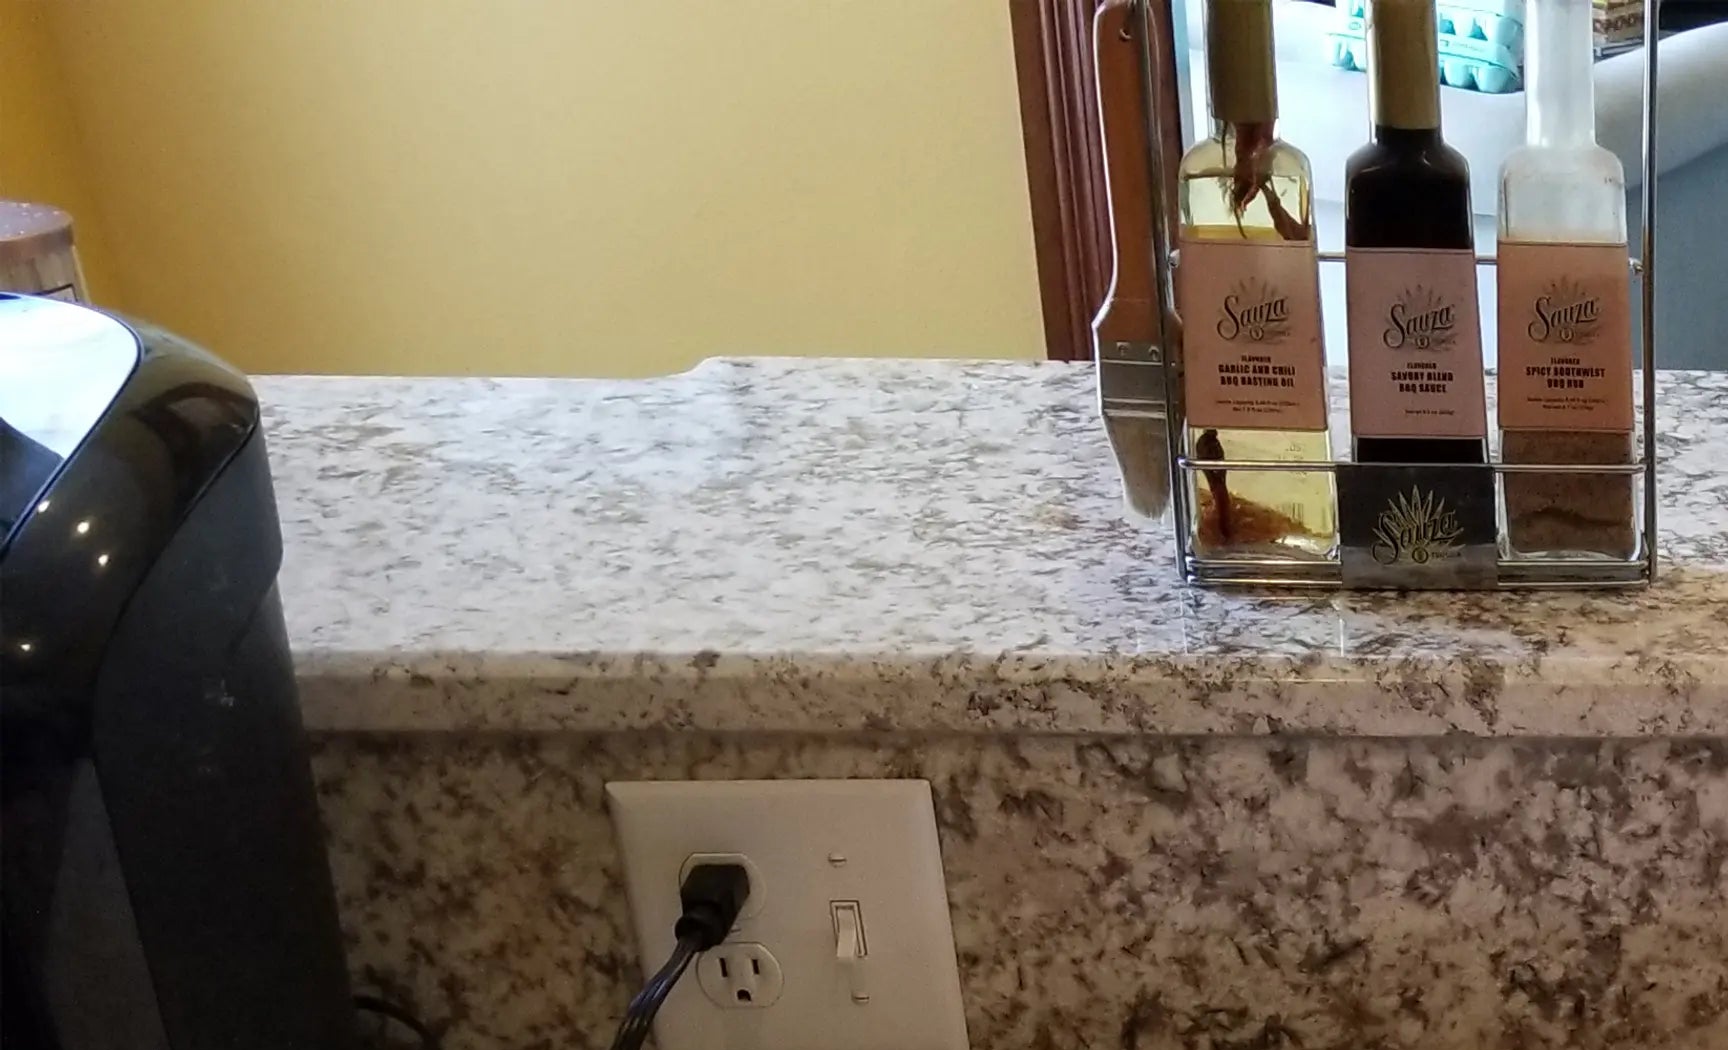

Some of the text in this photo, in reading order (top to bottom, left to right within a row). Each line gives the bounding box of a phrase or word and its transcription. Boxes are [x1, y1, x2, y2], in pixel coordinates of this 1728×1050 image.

[1216, 294, 1289, 341] Sauza
[1527, 296, 1599, 342] Sauza
[1383, 303, 1455, 349] Sauza
[1218, 364, 1296, 376] GARLIC AND CHILI
[1526, 366, 1606, 378] SPICY SOUTHWEST
[1220, 375, 1295, 388] BBQ BASTING OIL
[1391, 371, 1454, 382] SAVORY BLEND
[1399, 383, 1447, 394] BBQ SAUCE
[1547, 378, 1584, 389] BBQ RUB
[1371, 511, 1458, 566] Sauza
